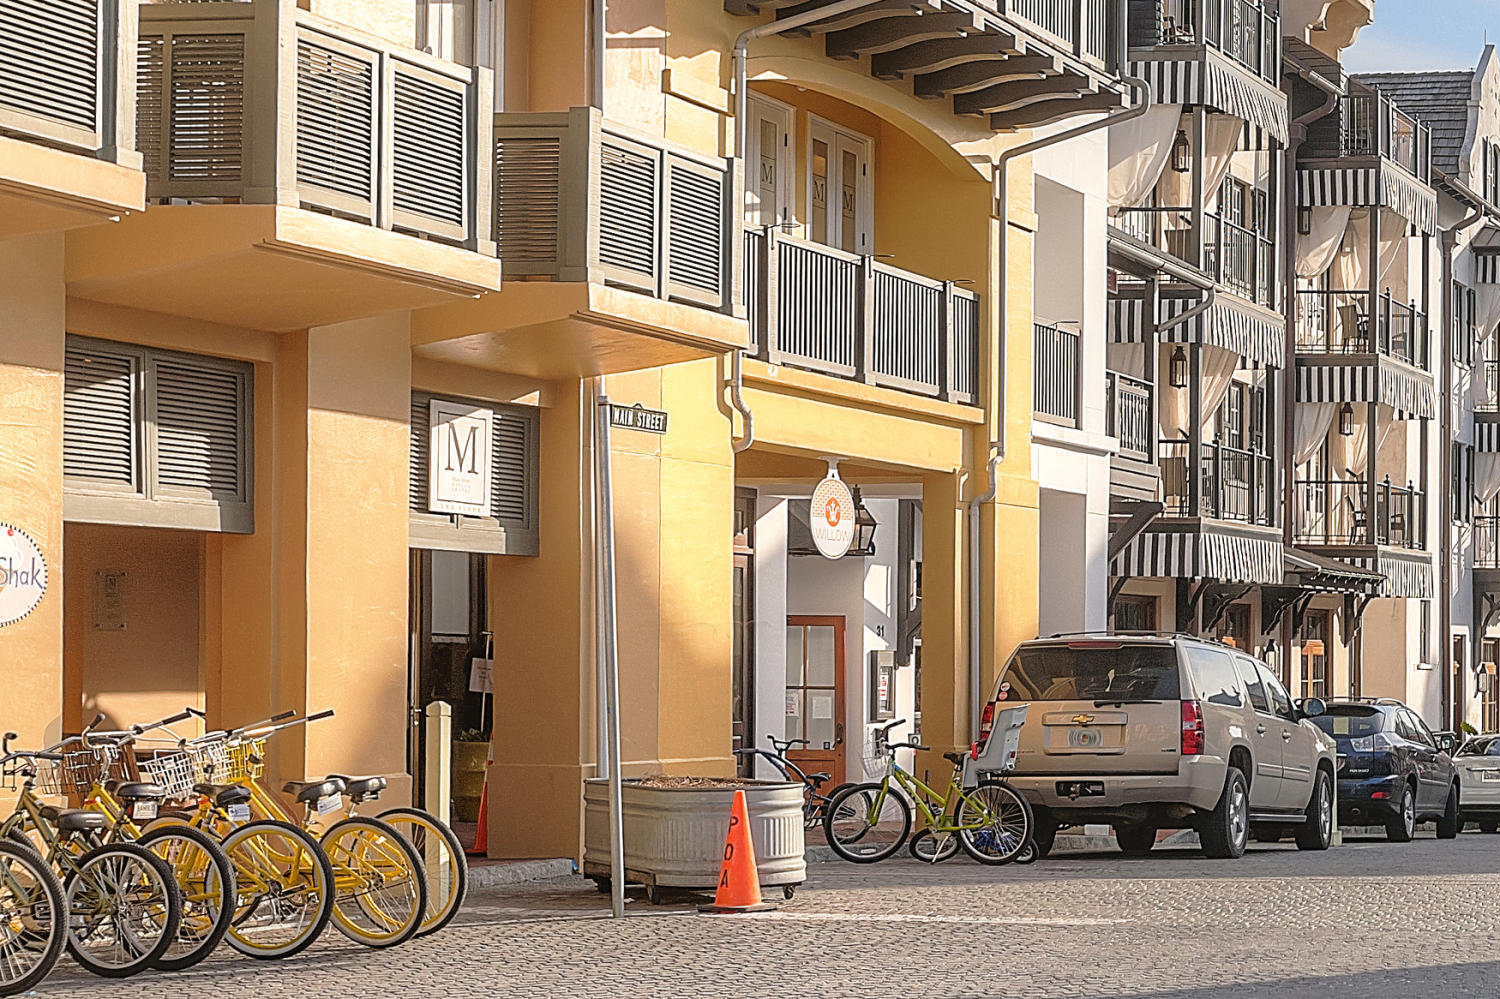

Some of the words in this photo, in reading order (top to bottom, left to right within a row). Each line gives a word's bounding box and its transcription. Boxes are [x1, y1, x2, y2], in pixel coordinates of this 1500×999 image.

[761, 162, 774, 185] M
[813, 180, 824, 203] M
[843, 190, 854, 212] M
[613, 407, 634, 426] MAIN
[637, 411, 665, 431] STREET
[444, 420, 480, 476] M
[815, 526, 850, 542] WILLOW
[877, 625, 885, 637] 31
